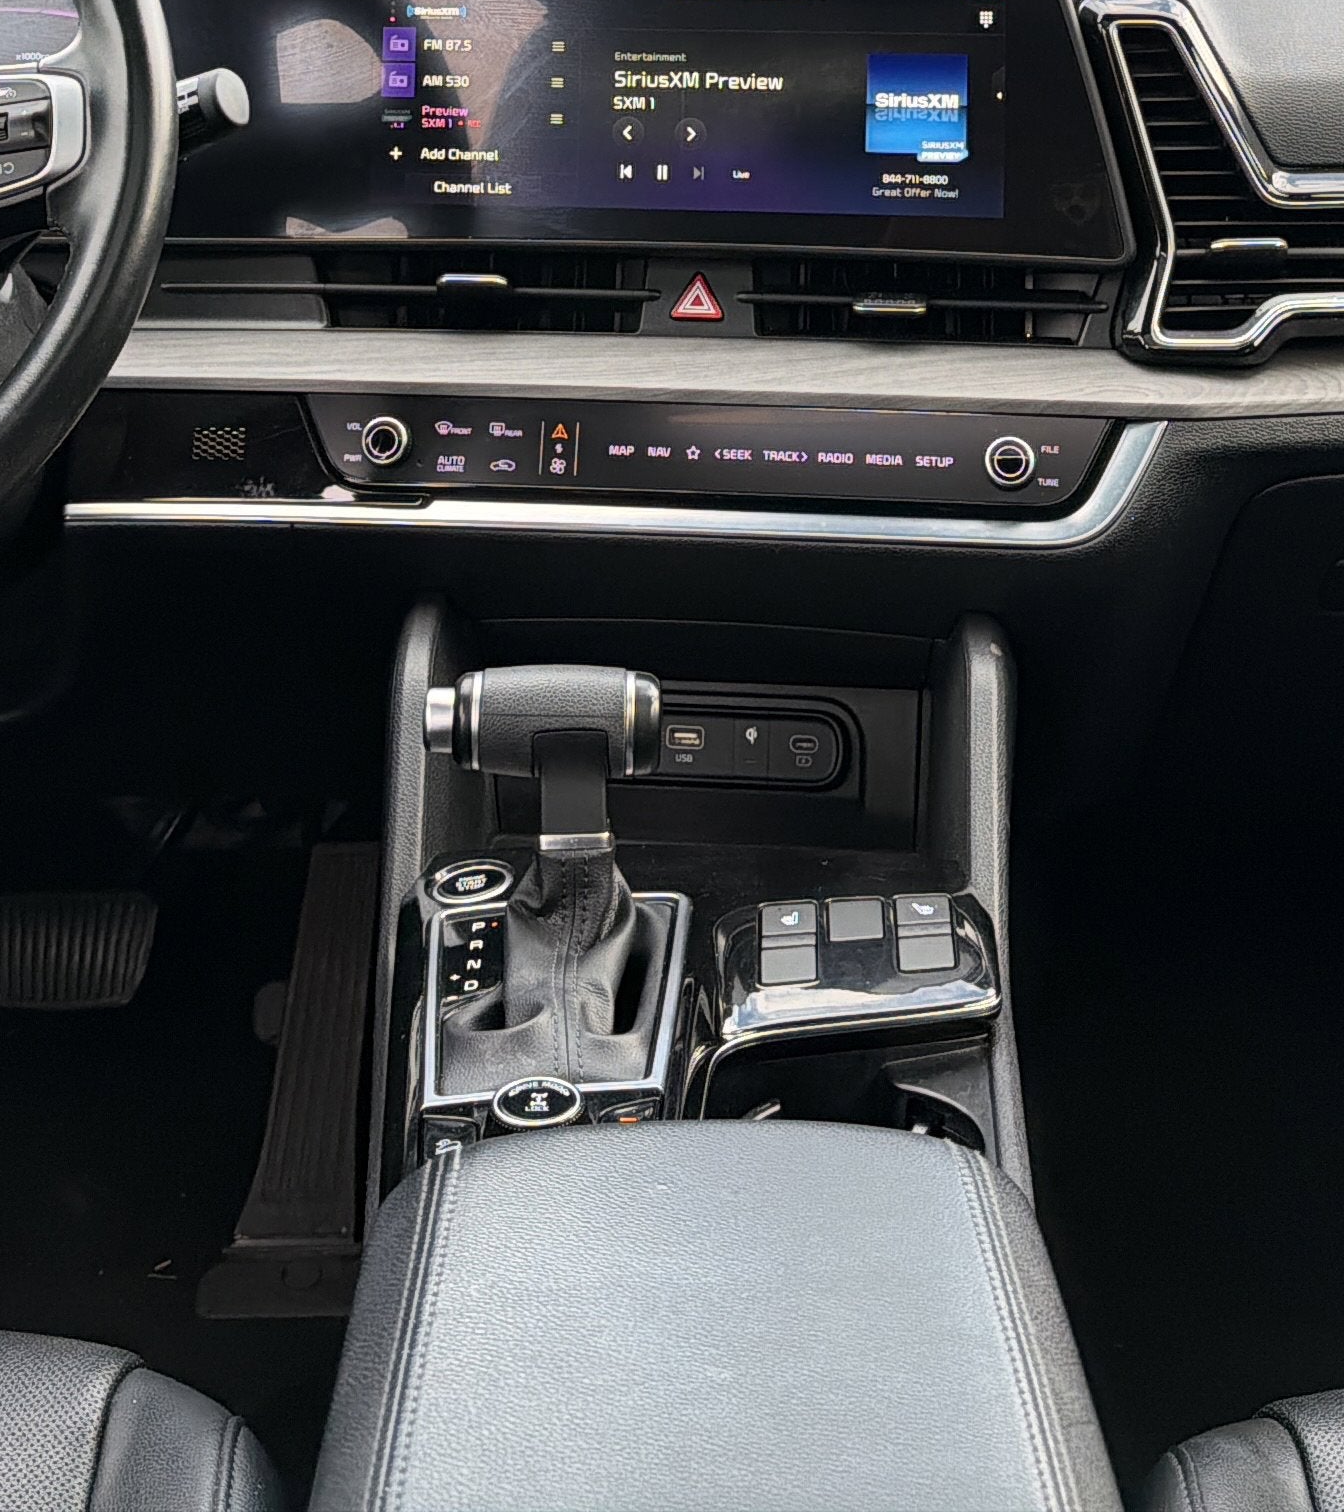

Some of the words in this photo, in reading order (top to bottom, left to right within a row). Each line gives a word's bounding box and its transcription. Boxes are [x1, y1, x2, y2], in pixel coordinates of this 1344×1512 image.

[423, 38, 443, 52] FM
[445, 39, 473, 52] 87.5
[614, 51, 687, 62] Entertainment
[422, 75, 443, 88] AM
[445, 75, 470, 88] 530
[614, 71, 699, 89] SiriusXM
[705, 72, 784, 91] Preview
[612, 96, 646, 110] SXM
[649, 97, 656, 110] 1
[874, 92, 959, 109] SiriusXM
[421, 105, 469, 118] Preview
[421, 118, 446, 129] SXM
[448, 118, 453, 129] 1
[420, 147, 445, 161] Add
[447, 148, 499, 162] Channel
[433, 181, 485, 194] Channel
[487, 182, 513, 195] List
[872, 187, 902, 197] Great
[904, 187, 932, 198] Offer
[346, 422, 362, 432] VOL
[450, 426, 473, 436] FRONT
[504, 429, 523, 438] REAR
[608, 445, 635, 457] MAP
[647, 446, 671, 458] NAV
[1040, 445, 1060, 455] FILE
[343, 453, 362, 463] PWR
[437, 455, 466, 465] AUTO
[817, 452, 854, 464] RADIO
[865, 453, 903, 466] MEDIA
[915, 455, 954, 468] SETUP
[436, 464, 465, 473] CLIMATE
[1037, 477, 1059, 487] TUNE
[674, 753, 694, 763] USB
[471, 921, 486, 932] P
[466, 958, 482, 970] N
[463, 979, 479, 991] D
